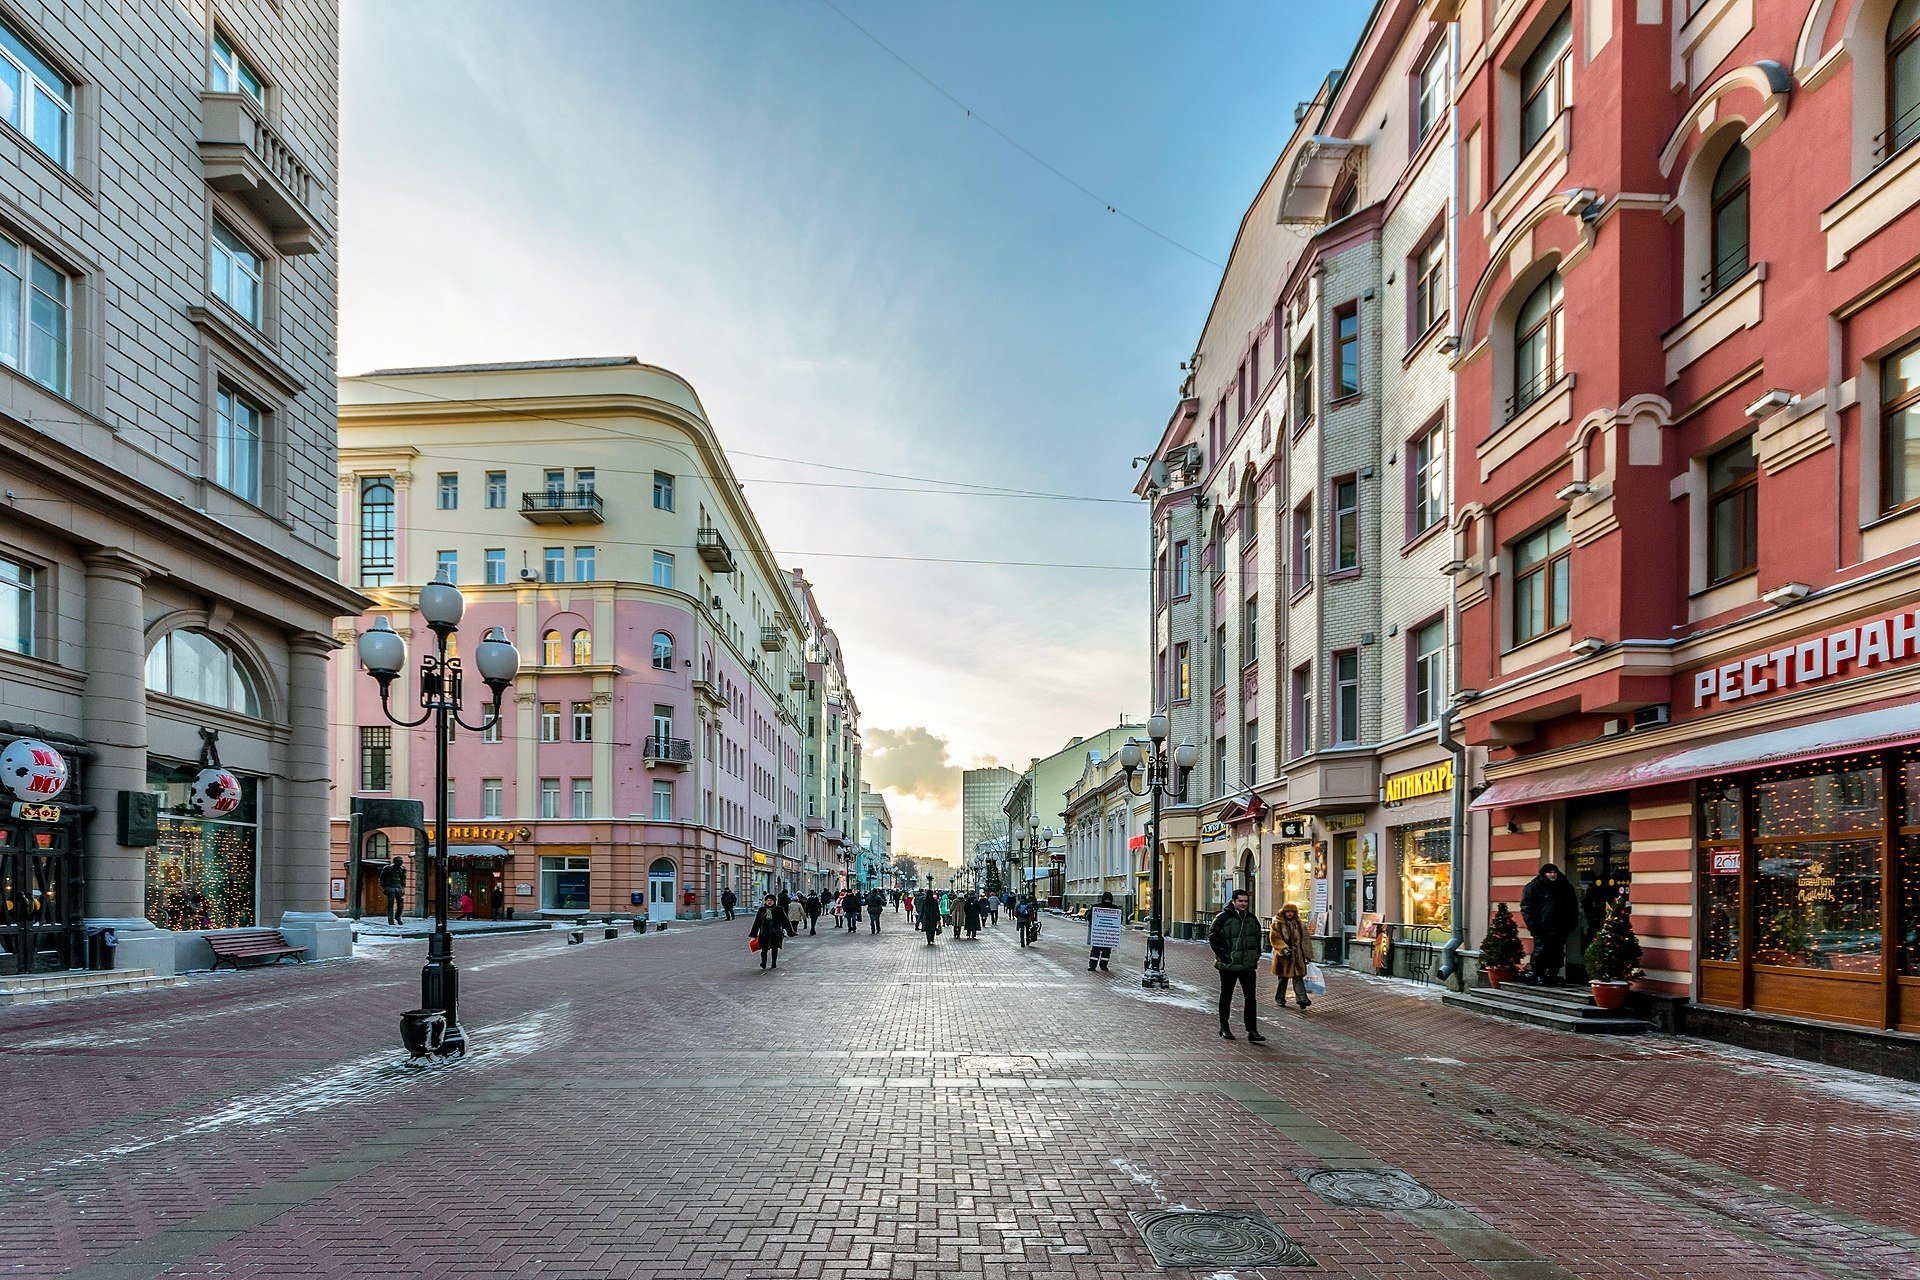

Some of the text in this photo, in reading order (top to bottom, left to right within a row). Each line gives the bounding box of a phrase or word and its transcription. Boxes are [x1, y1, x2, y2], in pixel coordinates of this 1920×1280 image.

[1694, 609, 1920, 708] РЕСТОРАН
[1386, 760, 1454, 802] АНТИКВАРЪ
[22, 807, 58, 818] КАФЕ
